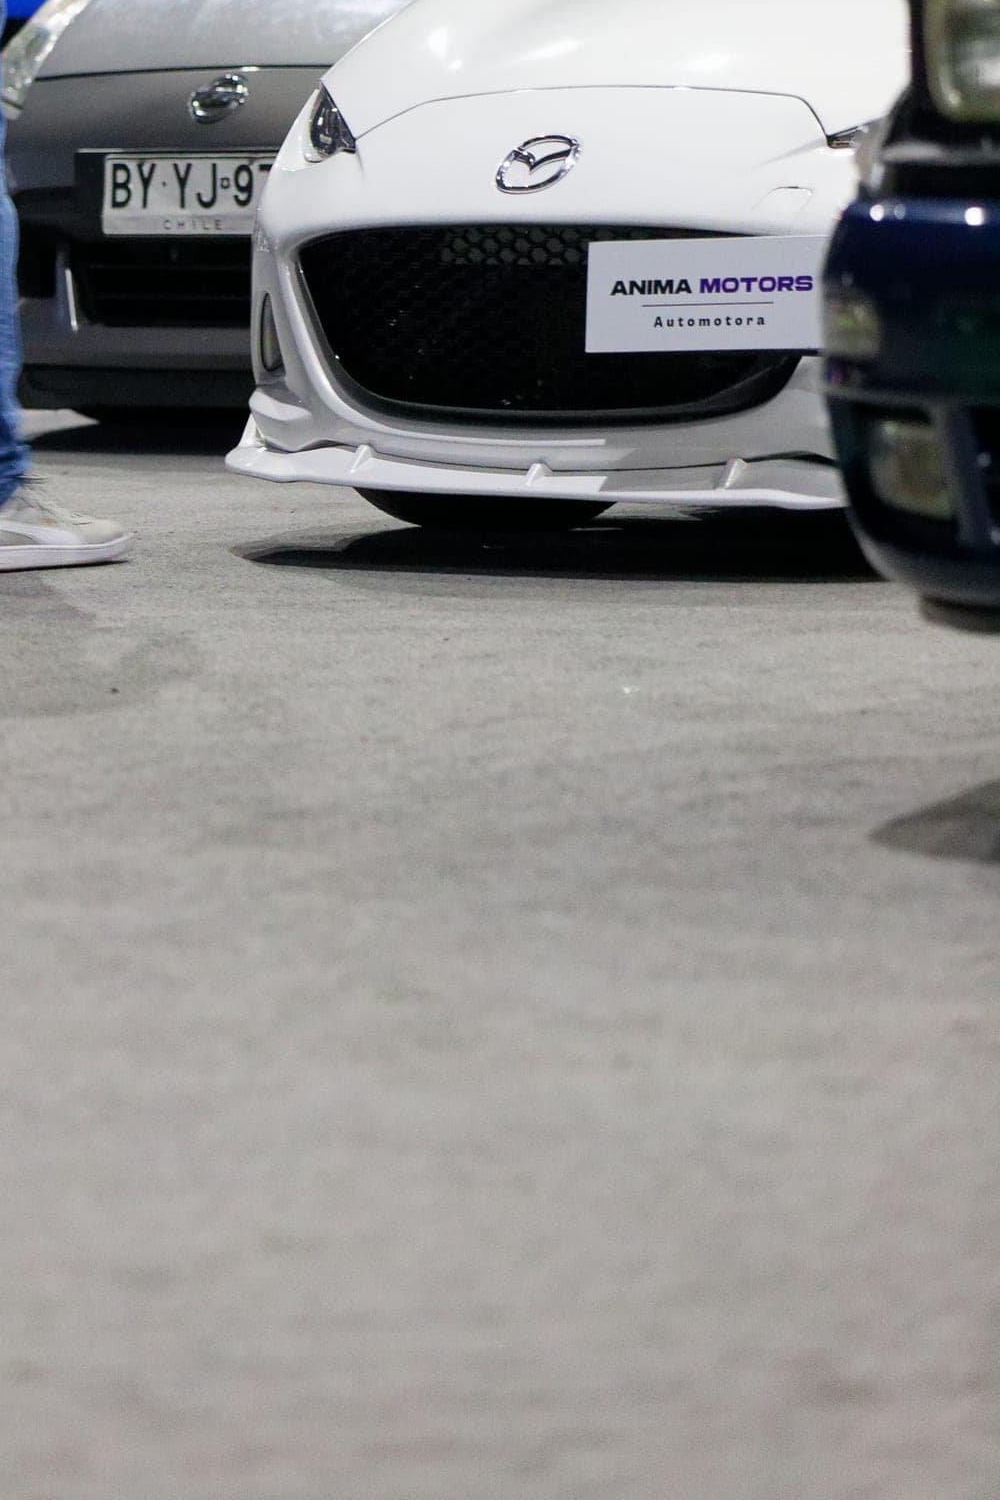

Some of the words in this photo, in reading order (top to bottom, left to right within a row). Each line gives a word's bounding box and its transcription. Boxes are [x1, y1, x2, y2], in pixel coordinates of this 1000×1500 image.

[162, 219, 224, 231] CHILE
[610, 278, 693, 296] ANIMA
[699, 275, 813, 294] MOTORS
[653, 315, 766, 329] Automotora
